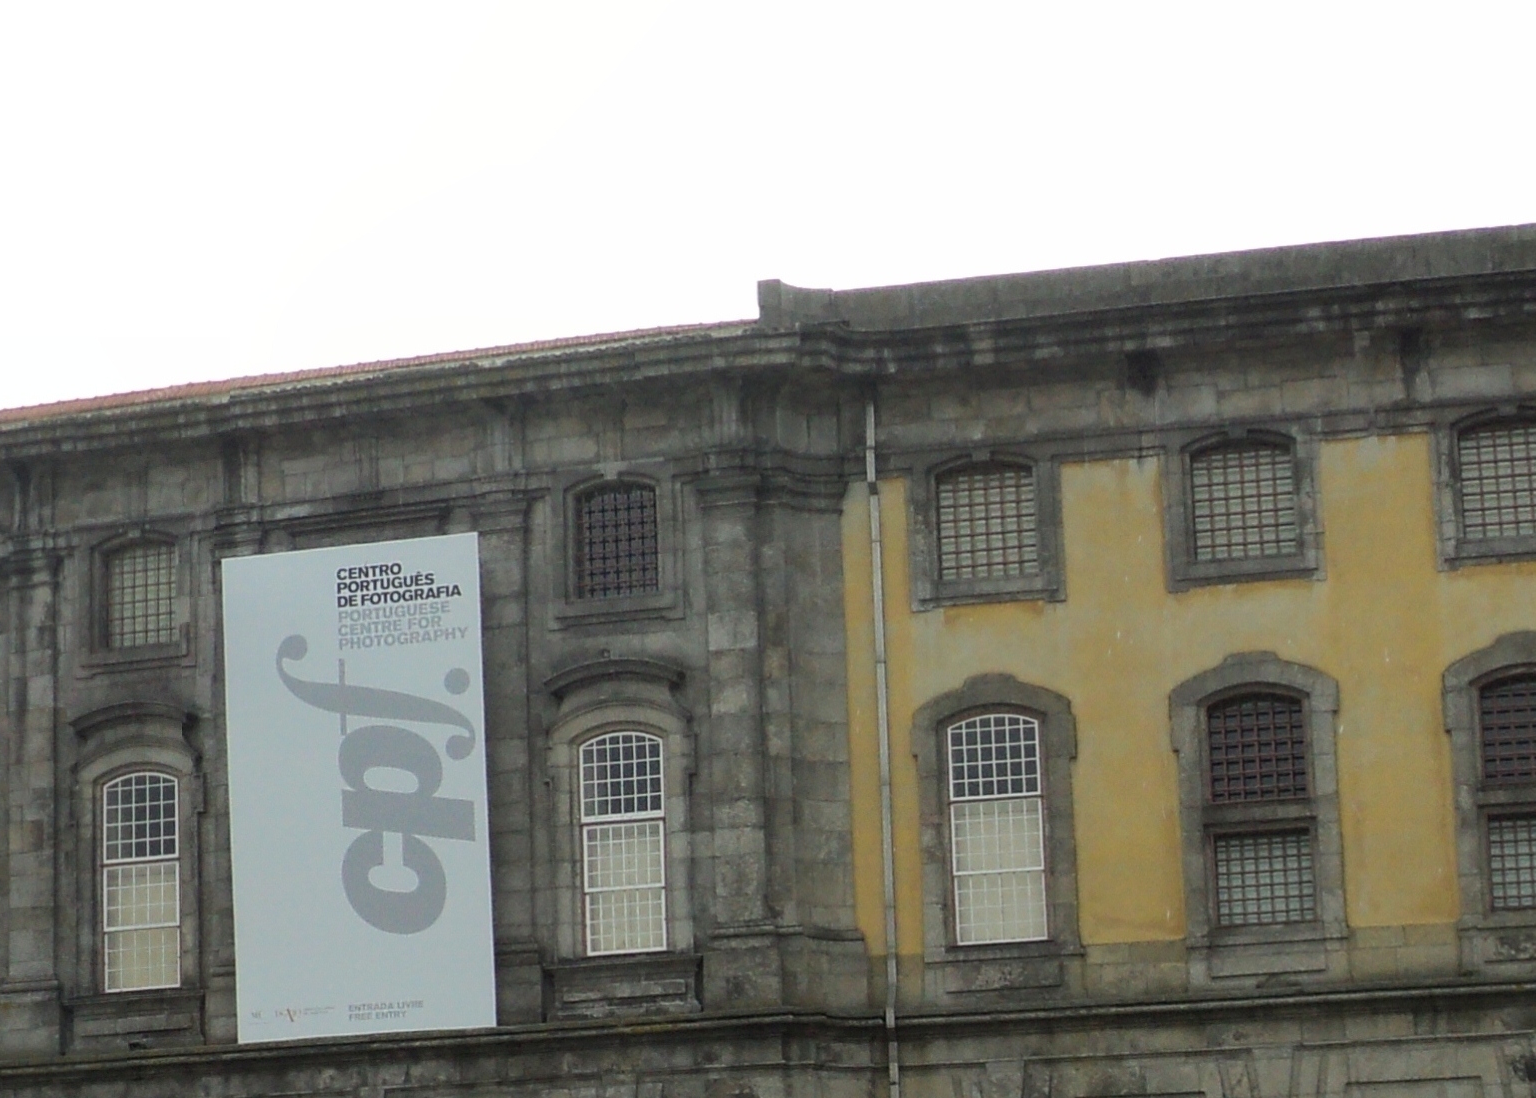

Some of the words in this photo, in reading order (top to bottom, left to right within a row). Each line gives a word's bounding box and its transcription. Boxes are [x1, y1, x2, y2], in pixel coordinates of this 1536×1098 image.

[336, 563, 402, 581] CENTRO
[336, 571, 435, 594] PORTUGUÊS
[337, 594, 359, 608] DE
[361, 584, 462, 606] FOTOGRAFIA
[338, 600, 451, 623] PORTUGUESE
[338, 619, 403, 637] CENTRE
[408, 615, 442, 630] FOR
[338, 627, 468, 650] PHOTOGRAPHY
[348, 1002, 393, 1012] ENTRADA
[396, 1000, 424, 1009] LIVRE
[349, 1012, 373, 1022] FREE
[375, 1010, 408, 1020] ENTRY
